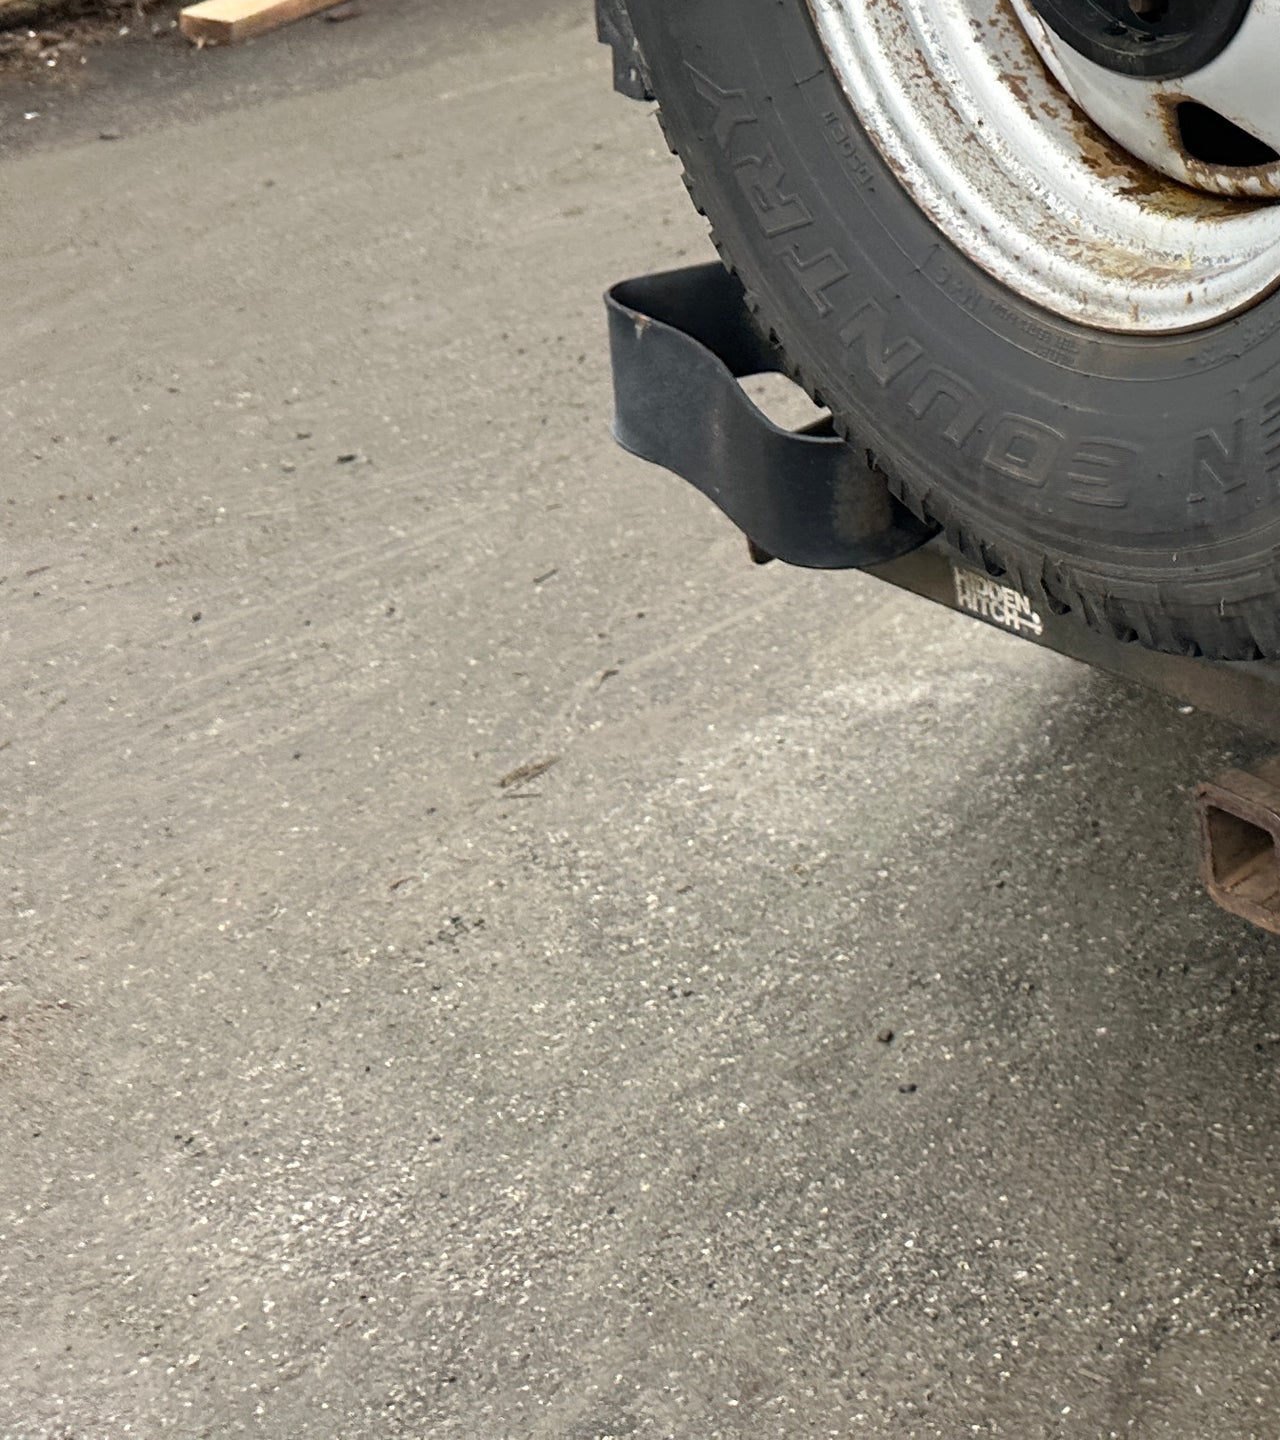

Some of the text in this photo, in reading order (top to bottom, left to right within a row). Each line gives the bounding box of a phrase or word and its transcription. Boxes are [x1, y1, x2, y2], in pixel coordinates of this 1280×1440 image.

[682, 58, 1146, 509] COUNTRY
[953, 565, 1031, 616] HIDDEN
[957, 589, 1022, 631] HITCH
